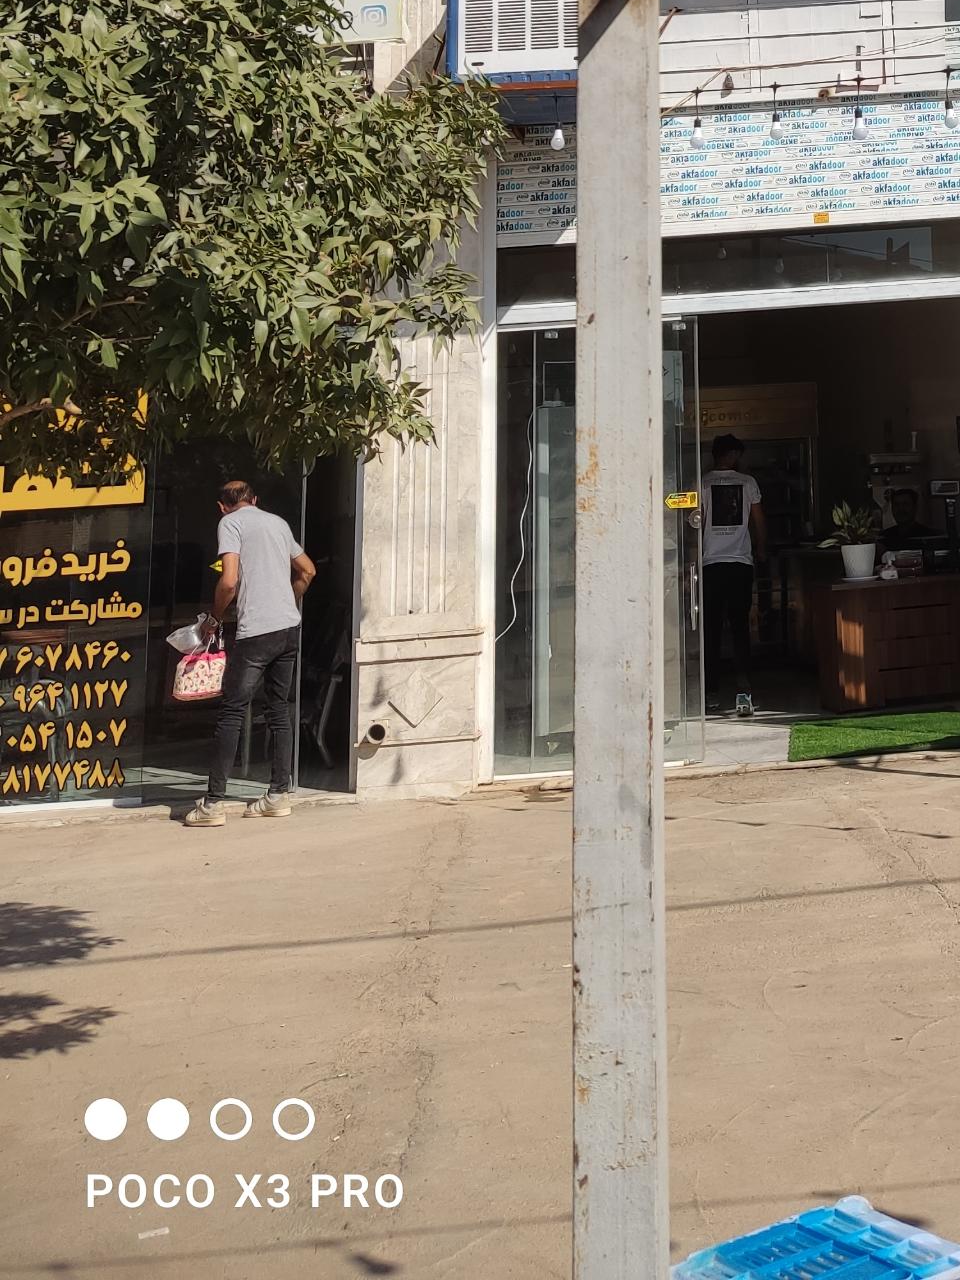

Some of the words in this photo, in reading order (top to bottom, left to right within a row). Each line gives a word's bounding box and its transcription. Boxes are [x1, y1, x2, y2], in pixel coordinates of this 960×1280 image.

[681, 169, 717, 179] akfadoor
[745, 165, 781, 175] akfadoor
[809, 160, 845, 171] akfadoor
[872, 156, 908, 167] akfadoor
[0, 548, 58, 587] فرو
[60, 538, 132, 583] خرید
[17, 605, 40, 629] در
[45, 590, 143, 626] مشارکت
[13, 682, 64, 713] ۹۶۴
[70, 679, 128, 710] ۱۱۲۷
[65, 718, 127, 750] ۱۵۰۷
